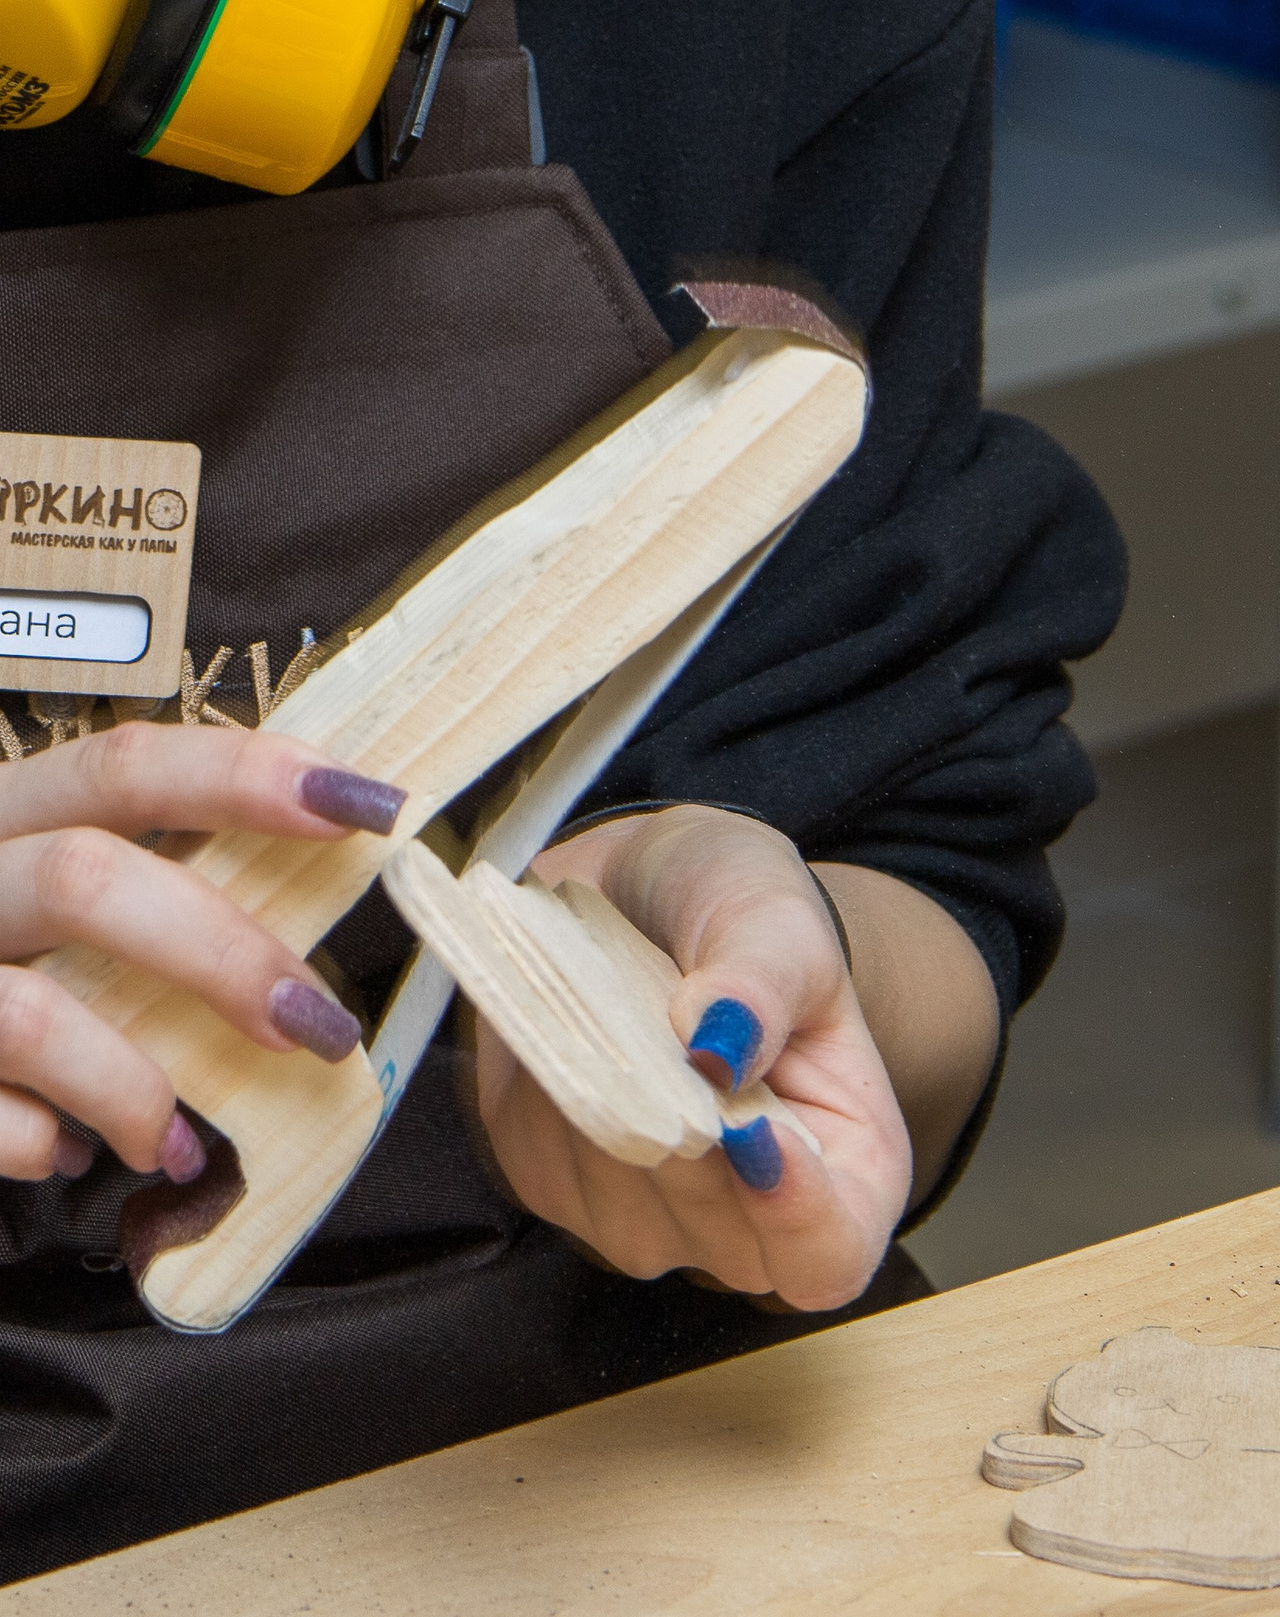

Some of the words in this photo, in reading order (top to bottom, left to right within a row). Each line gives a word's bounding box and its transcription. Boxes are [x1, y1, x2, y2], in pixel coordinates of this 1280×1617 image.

[10, 531, 95, 550] МАСТЕРСКАЯ
[99, 536, 125, 552] КАК
[126, 537, 137, 552] У
[139, 538, 178, 554] ПАПЫ
